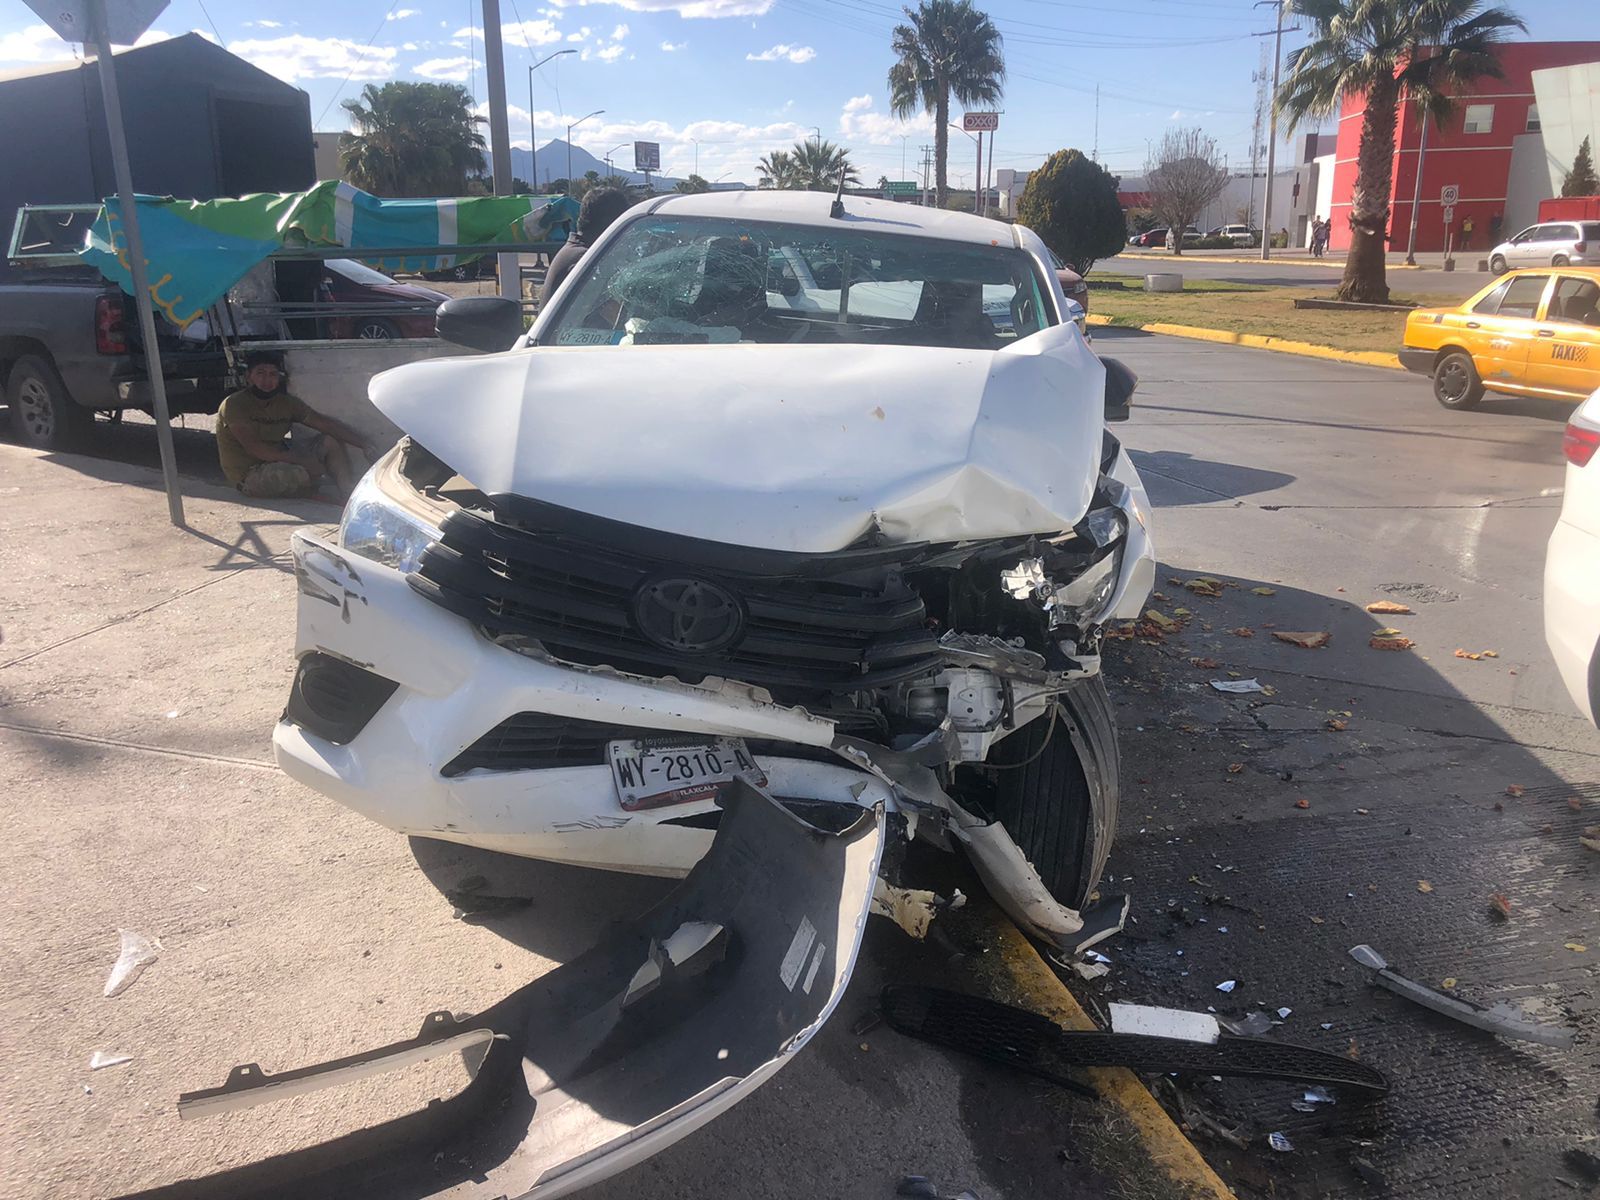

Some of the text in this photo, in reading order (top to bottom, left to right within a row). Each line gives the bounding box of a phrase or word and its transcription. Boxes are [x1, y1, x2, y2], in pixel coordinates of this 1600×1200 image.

[965, 115, 997, 128] OXXO
[1445, 190, 1455, 199] 40
[1552, 344, 1575, 361] TAXI
[616, 749, 753, 788] WY-2810-A
[680, 785, 719, 796] TLAXCALA
